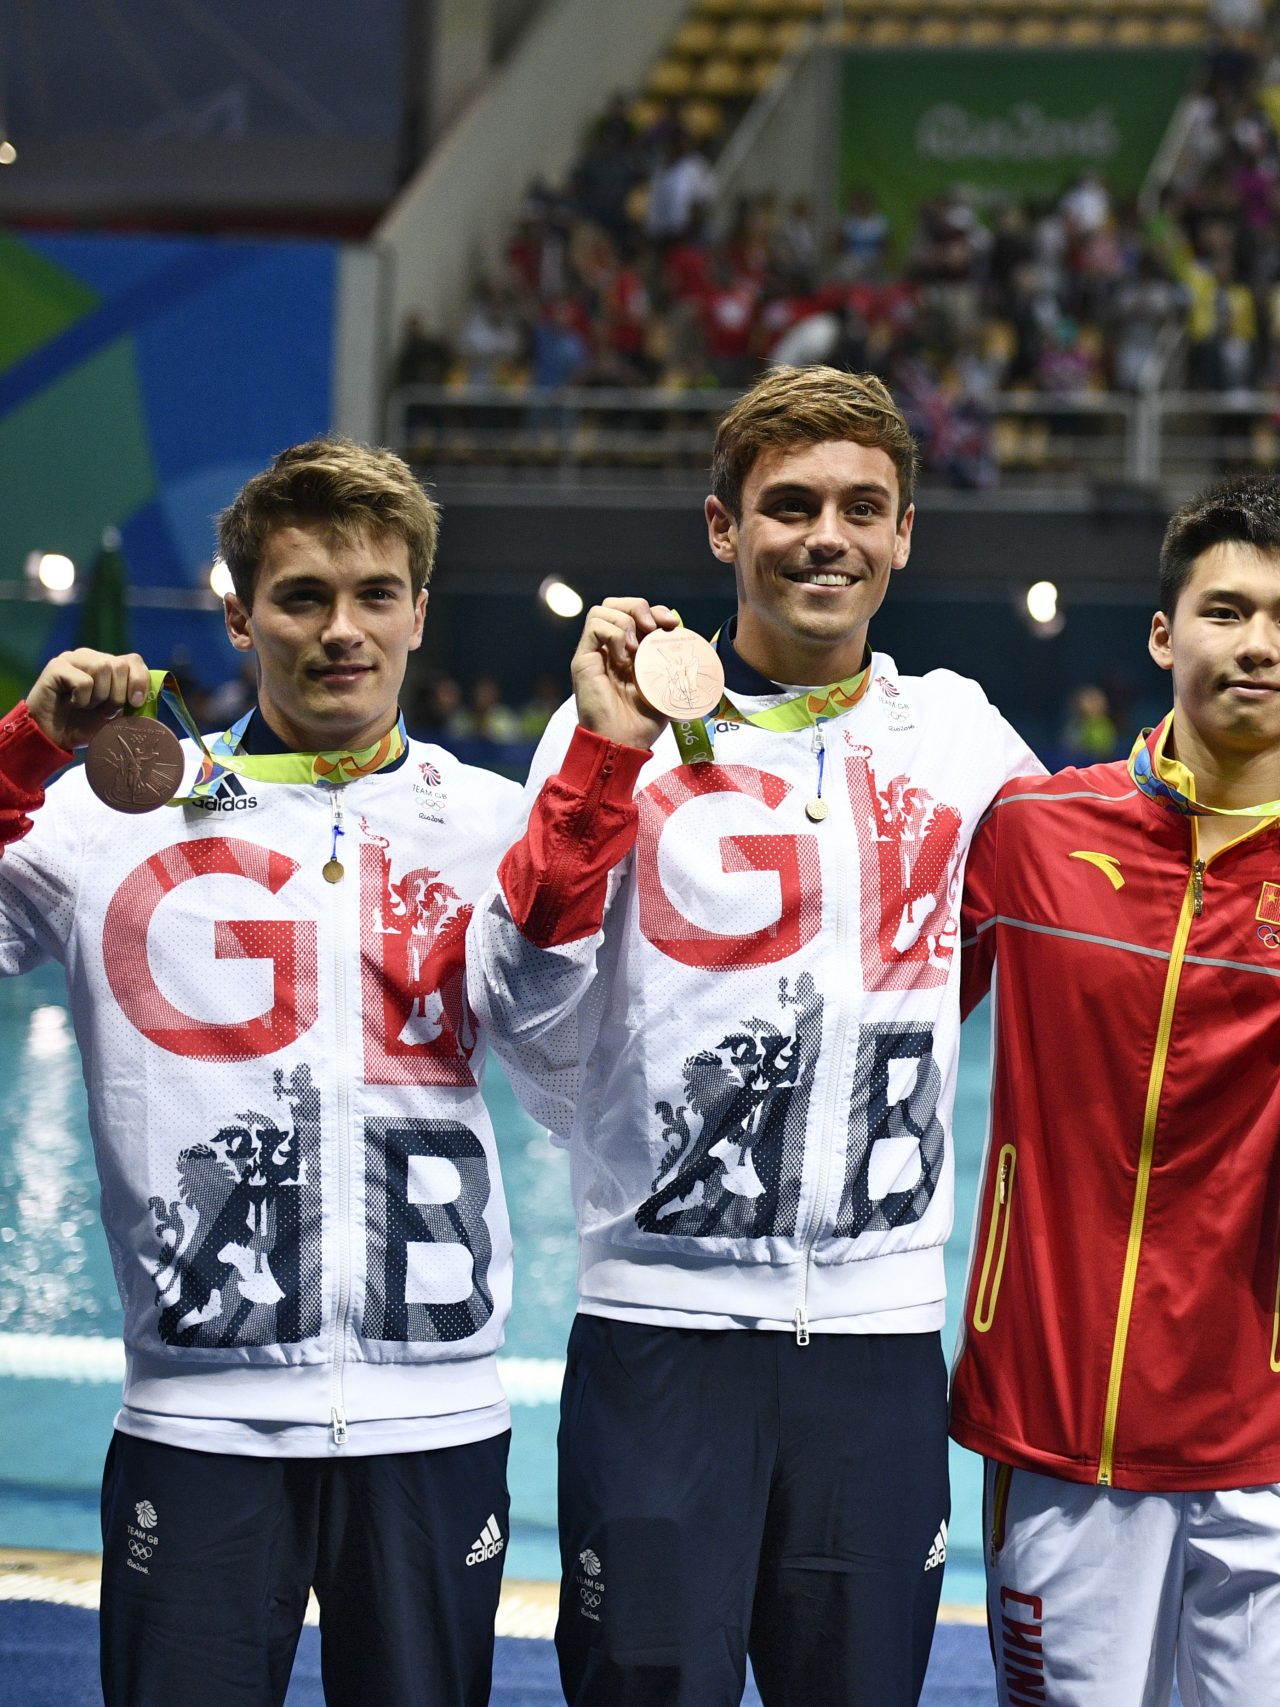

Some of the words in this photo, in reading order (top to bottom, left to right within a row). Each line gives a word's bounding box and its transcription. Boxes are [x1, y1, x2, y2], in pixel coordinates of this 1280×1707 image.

[412, 783, 433, 798] TEAM
[434, 792, 448, 800] GB
[191, 796, 258, 812] adidas
[127, 1525, 147, 1541] TEAM
[147, 1534, 159, 1546] GB
[465, 1537, 504, 1567] adidas
[594, 1582, 605, 1592] GB
